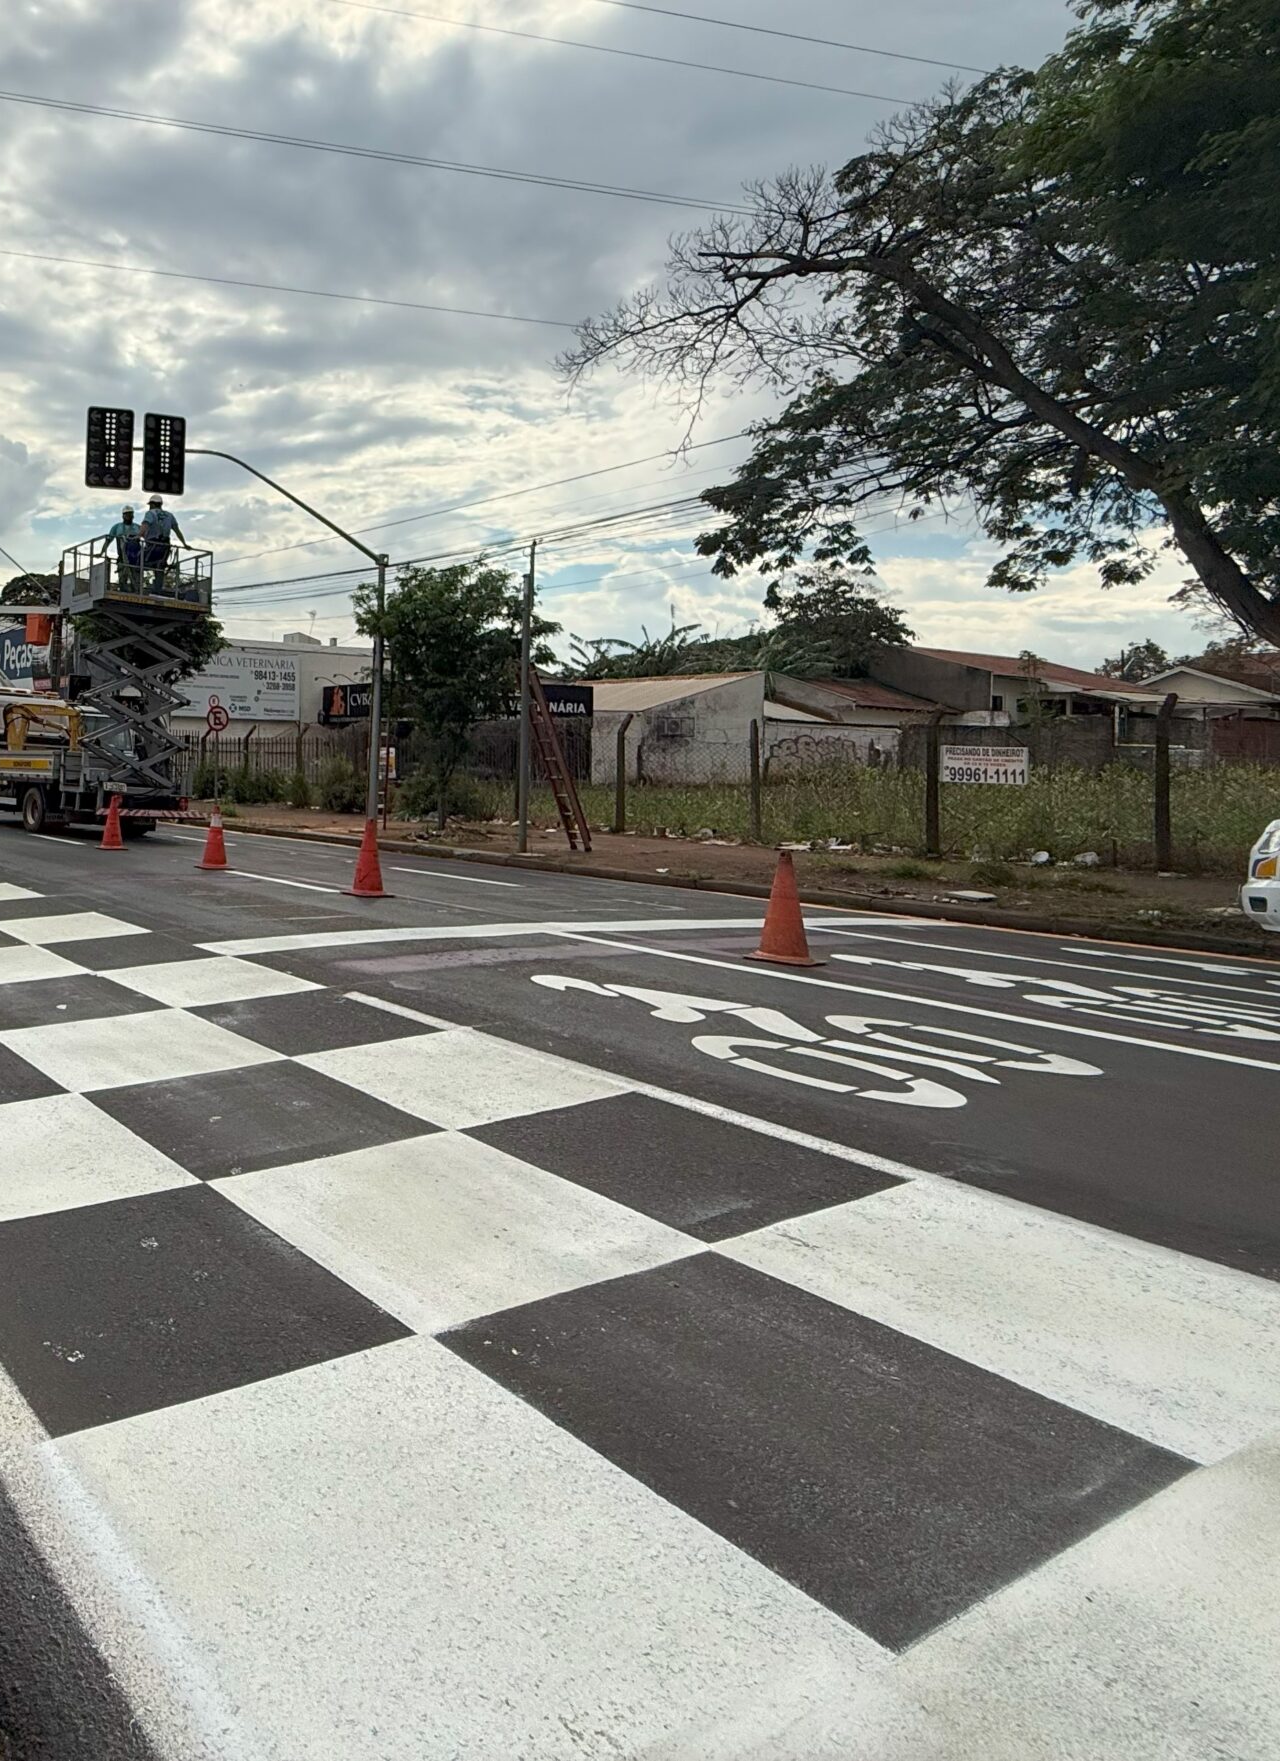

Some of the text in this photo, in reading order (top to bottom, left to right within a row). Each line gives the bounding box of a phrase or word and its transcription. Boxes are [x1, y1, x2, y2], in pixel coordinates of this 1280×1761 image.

[4, 640, 33, 676] Peças
[254, 670, 296, 682] 98413-1455
[945, 747, 1024, 757] PRECISANDO DE DINHEIRO?
[949, 766, 1025, 783] 99961-1111
